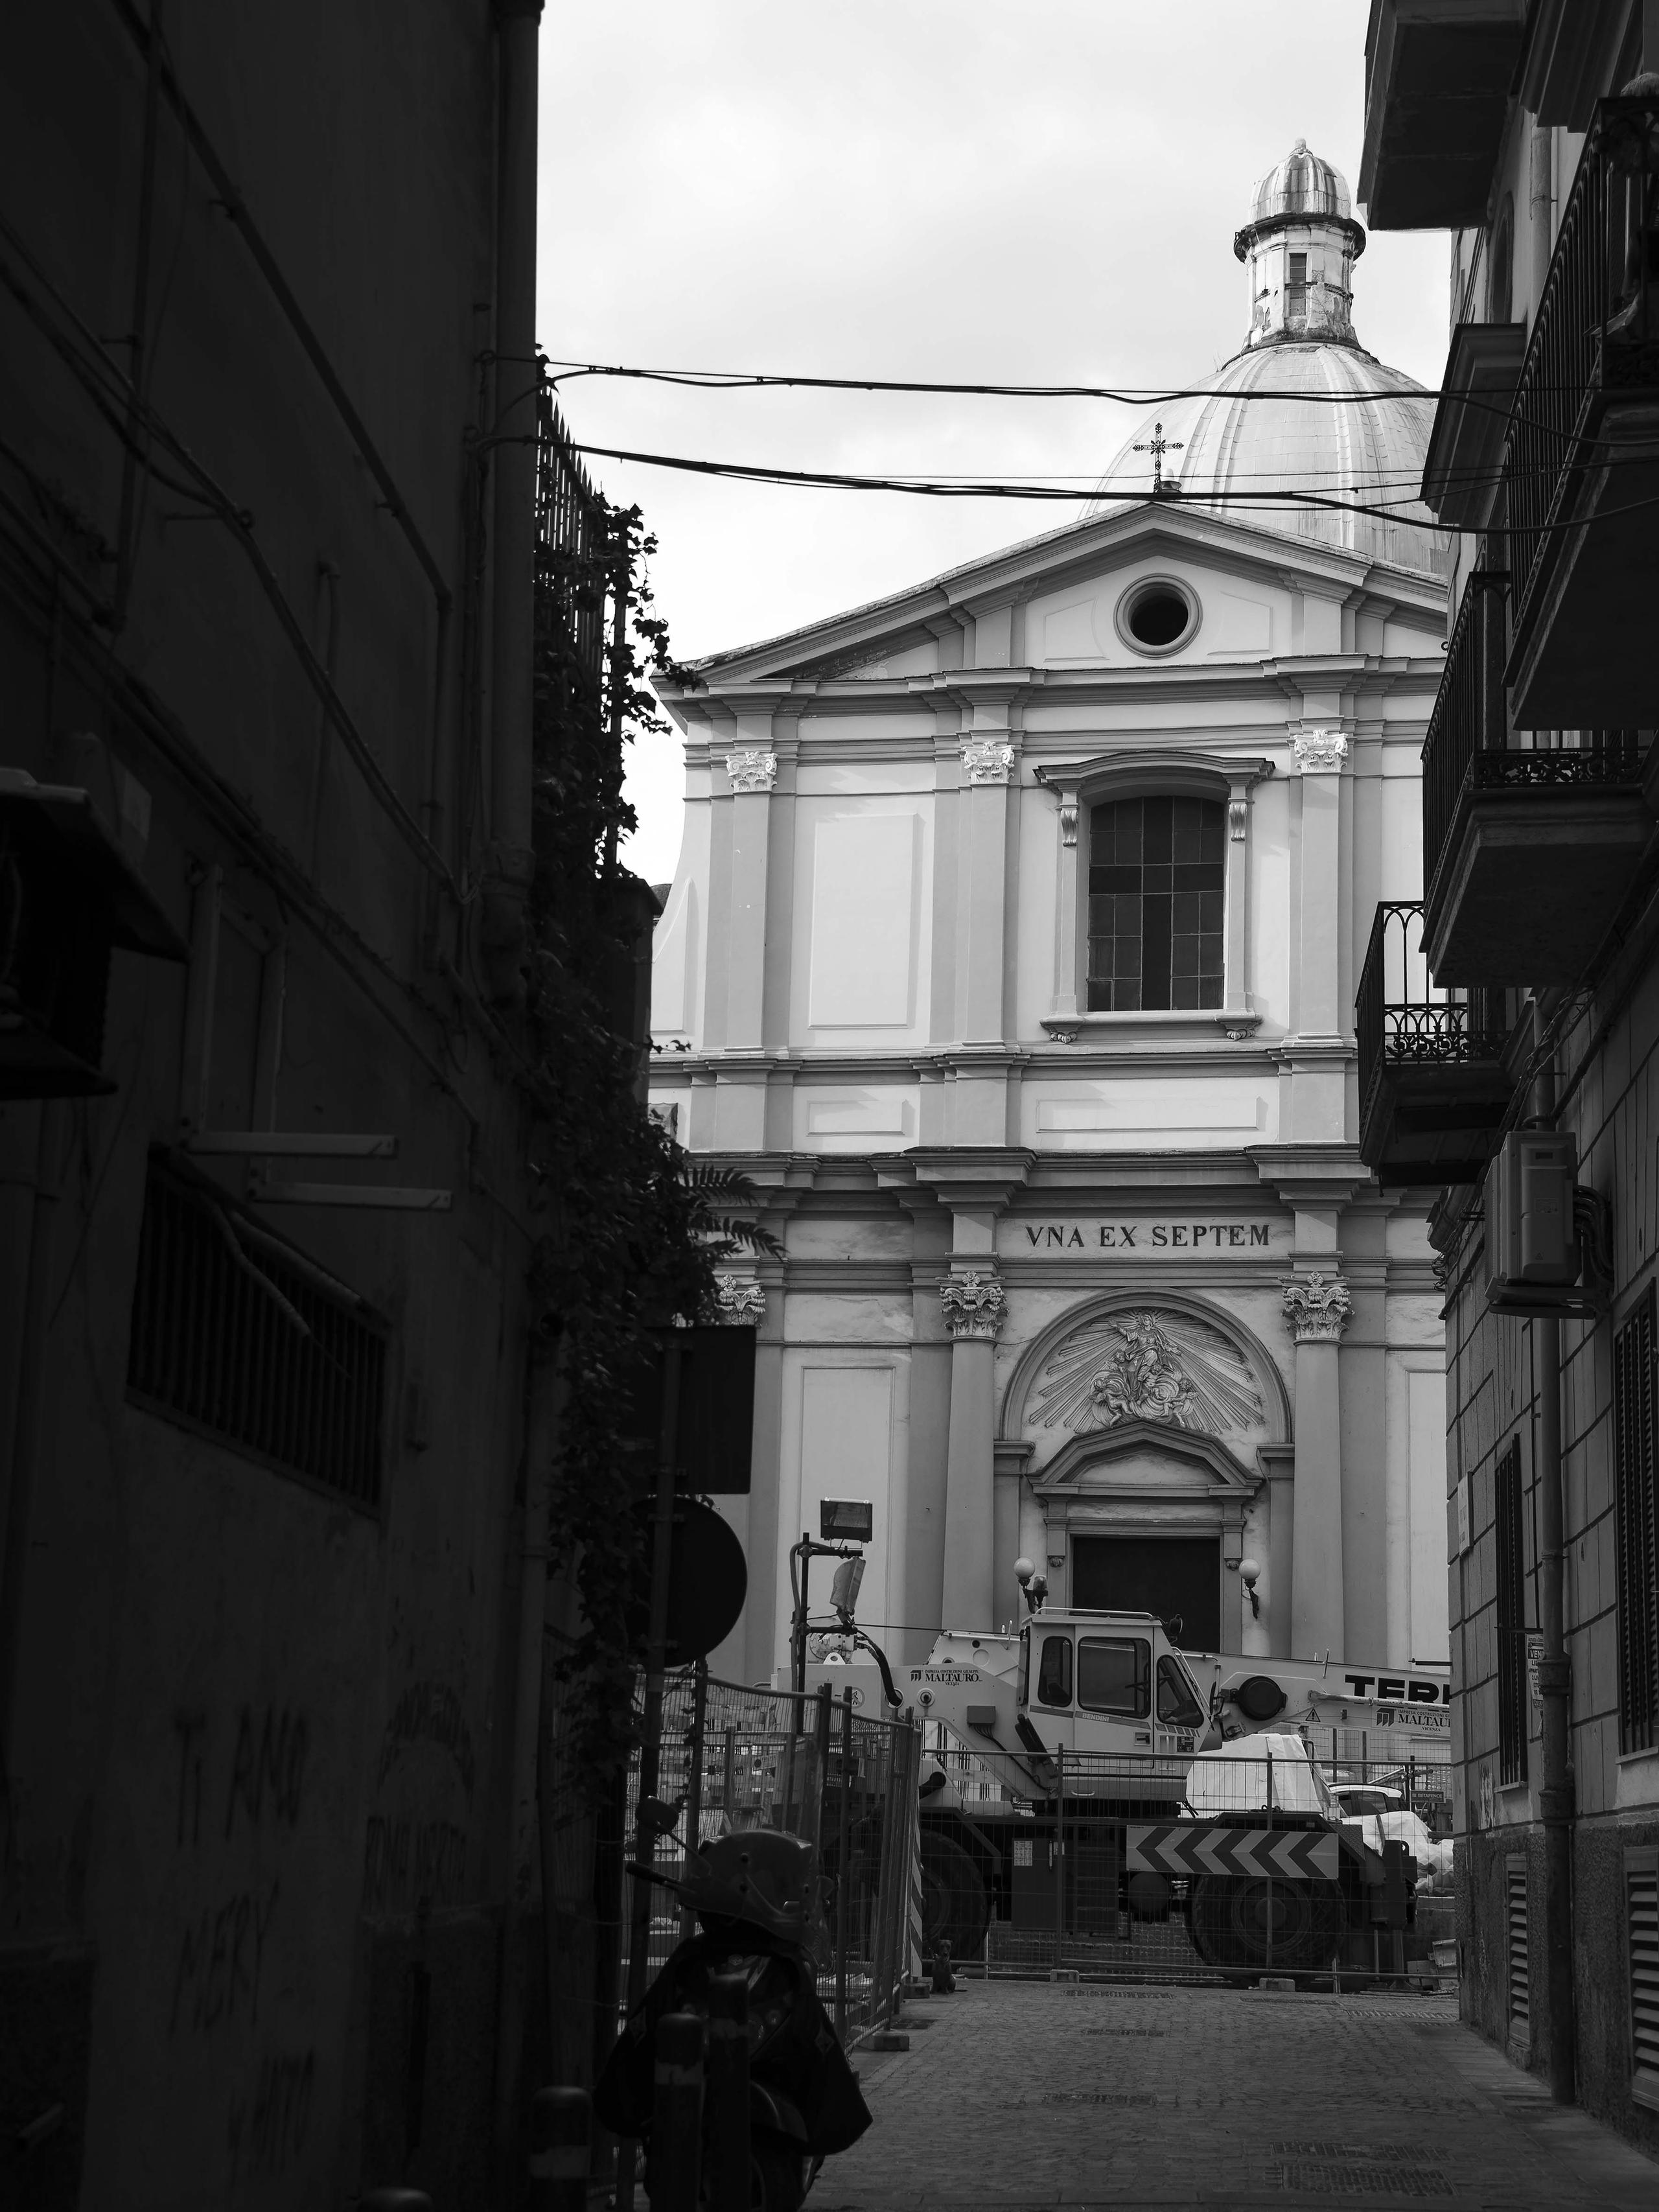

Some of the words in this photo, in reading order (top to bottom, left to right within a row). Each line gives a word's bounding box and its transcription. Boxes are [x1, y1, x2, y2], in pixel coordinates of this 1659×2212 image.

[1026, 1226, 1085, 1247] VNA
[1100, 1226, 1137, 1247] EX
[1152, 1224, 1270, 1246] SEPTEM
[925, 1673, 979, 1682] MALTAURO
[1082, 1712, 1109, 1722] BENDINI
[1398, 1714, 1450, 1727] MALTAU
